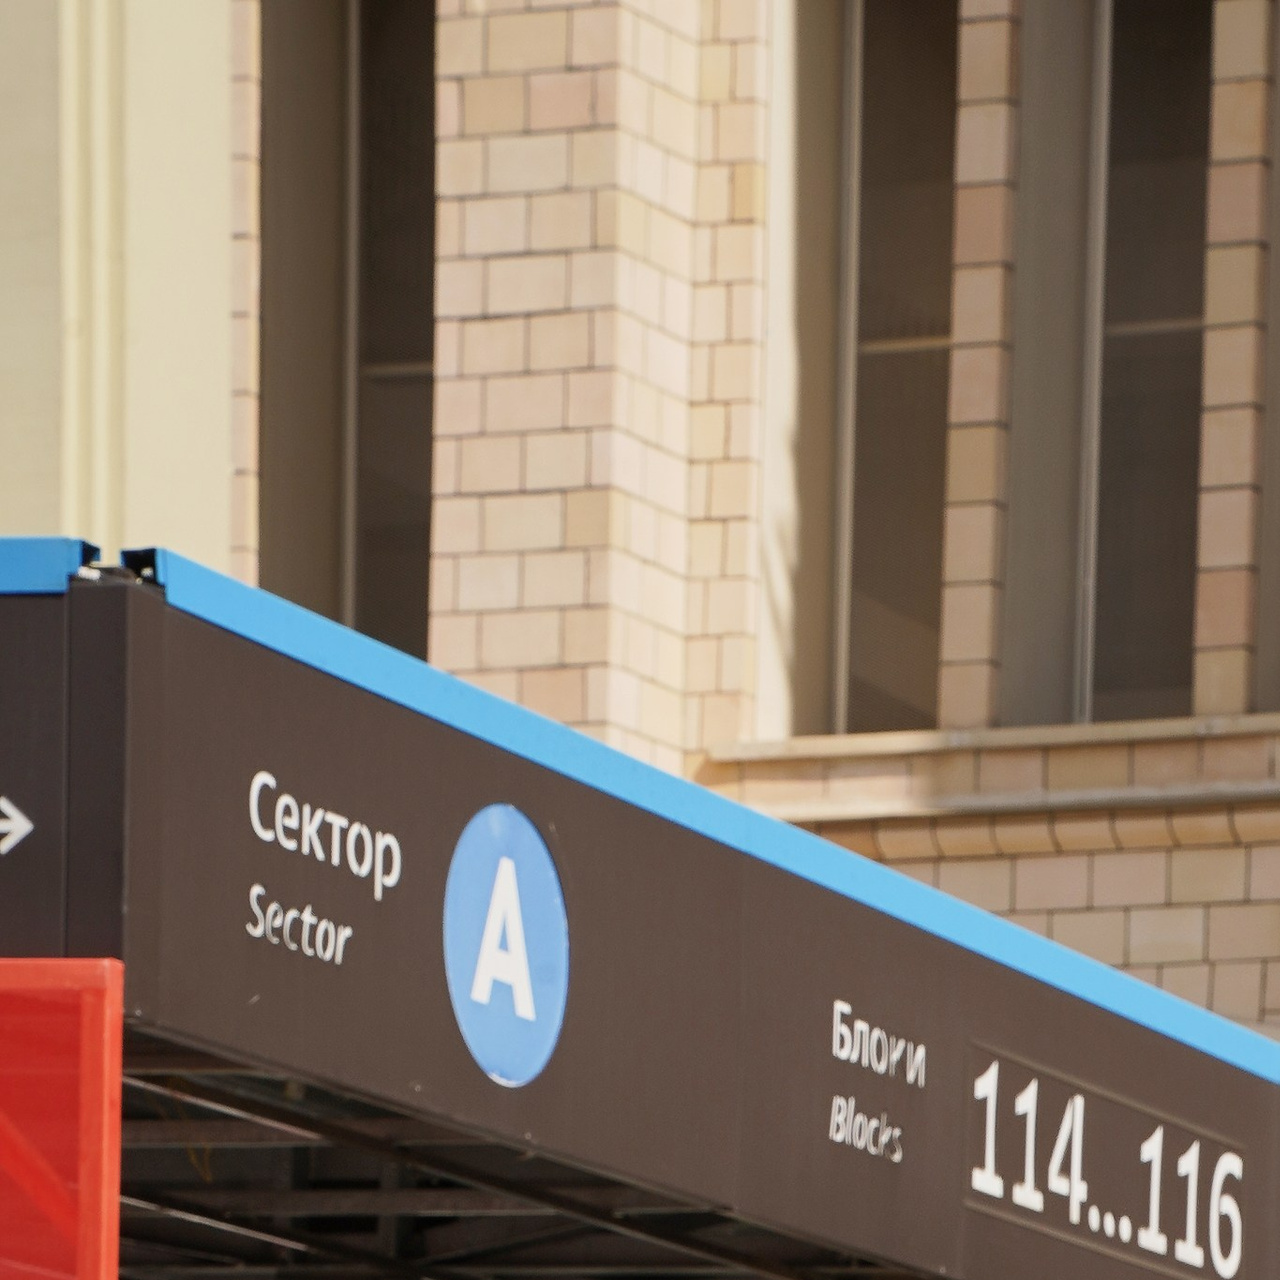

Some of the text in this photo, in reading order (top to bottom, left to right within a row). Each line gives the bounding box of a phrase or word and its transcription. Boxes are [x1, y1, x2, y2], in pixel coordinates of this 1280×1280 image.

[249, 770, 401, 901] Сектор
[246, 883, 354, 965] Sector
[470, 856, 537, 1021] A
[832, 999, 926, 1088] Блоки
[829, 1094, 903, 1163] Blocks
[971, 1060, 1244, 1280] 114...116
